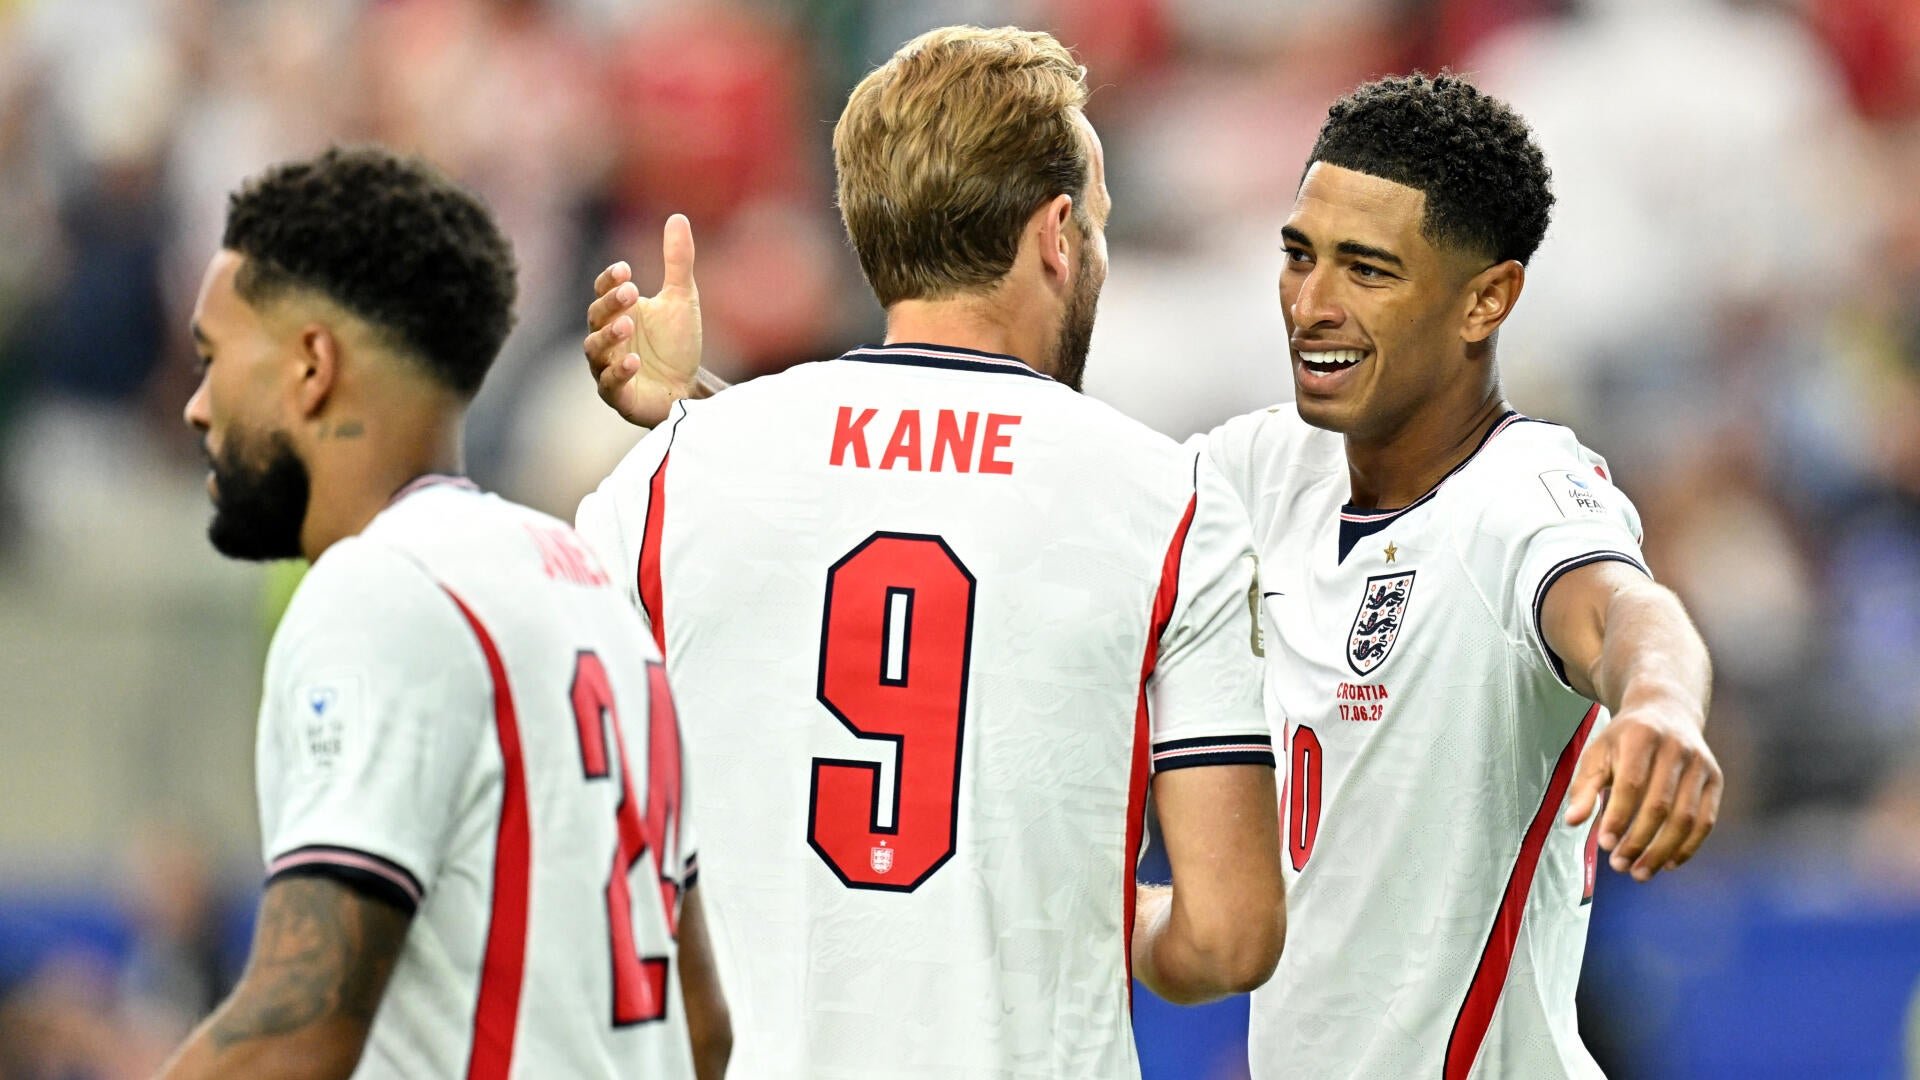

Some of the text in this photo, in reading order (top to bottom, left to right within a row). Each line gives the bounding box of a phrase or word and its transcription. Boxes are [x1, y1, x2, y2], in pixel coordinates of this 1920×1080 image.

[830, 405, 1022, 476] KANE
[806, 531, 978, 893] 9
[1336, 682, 1389, 701] CROATIA
[1339, 704, 1383, 721] 17.06.26
[569, 650, 683, 1028] 24
